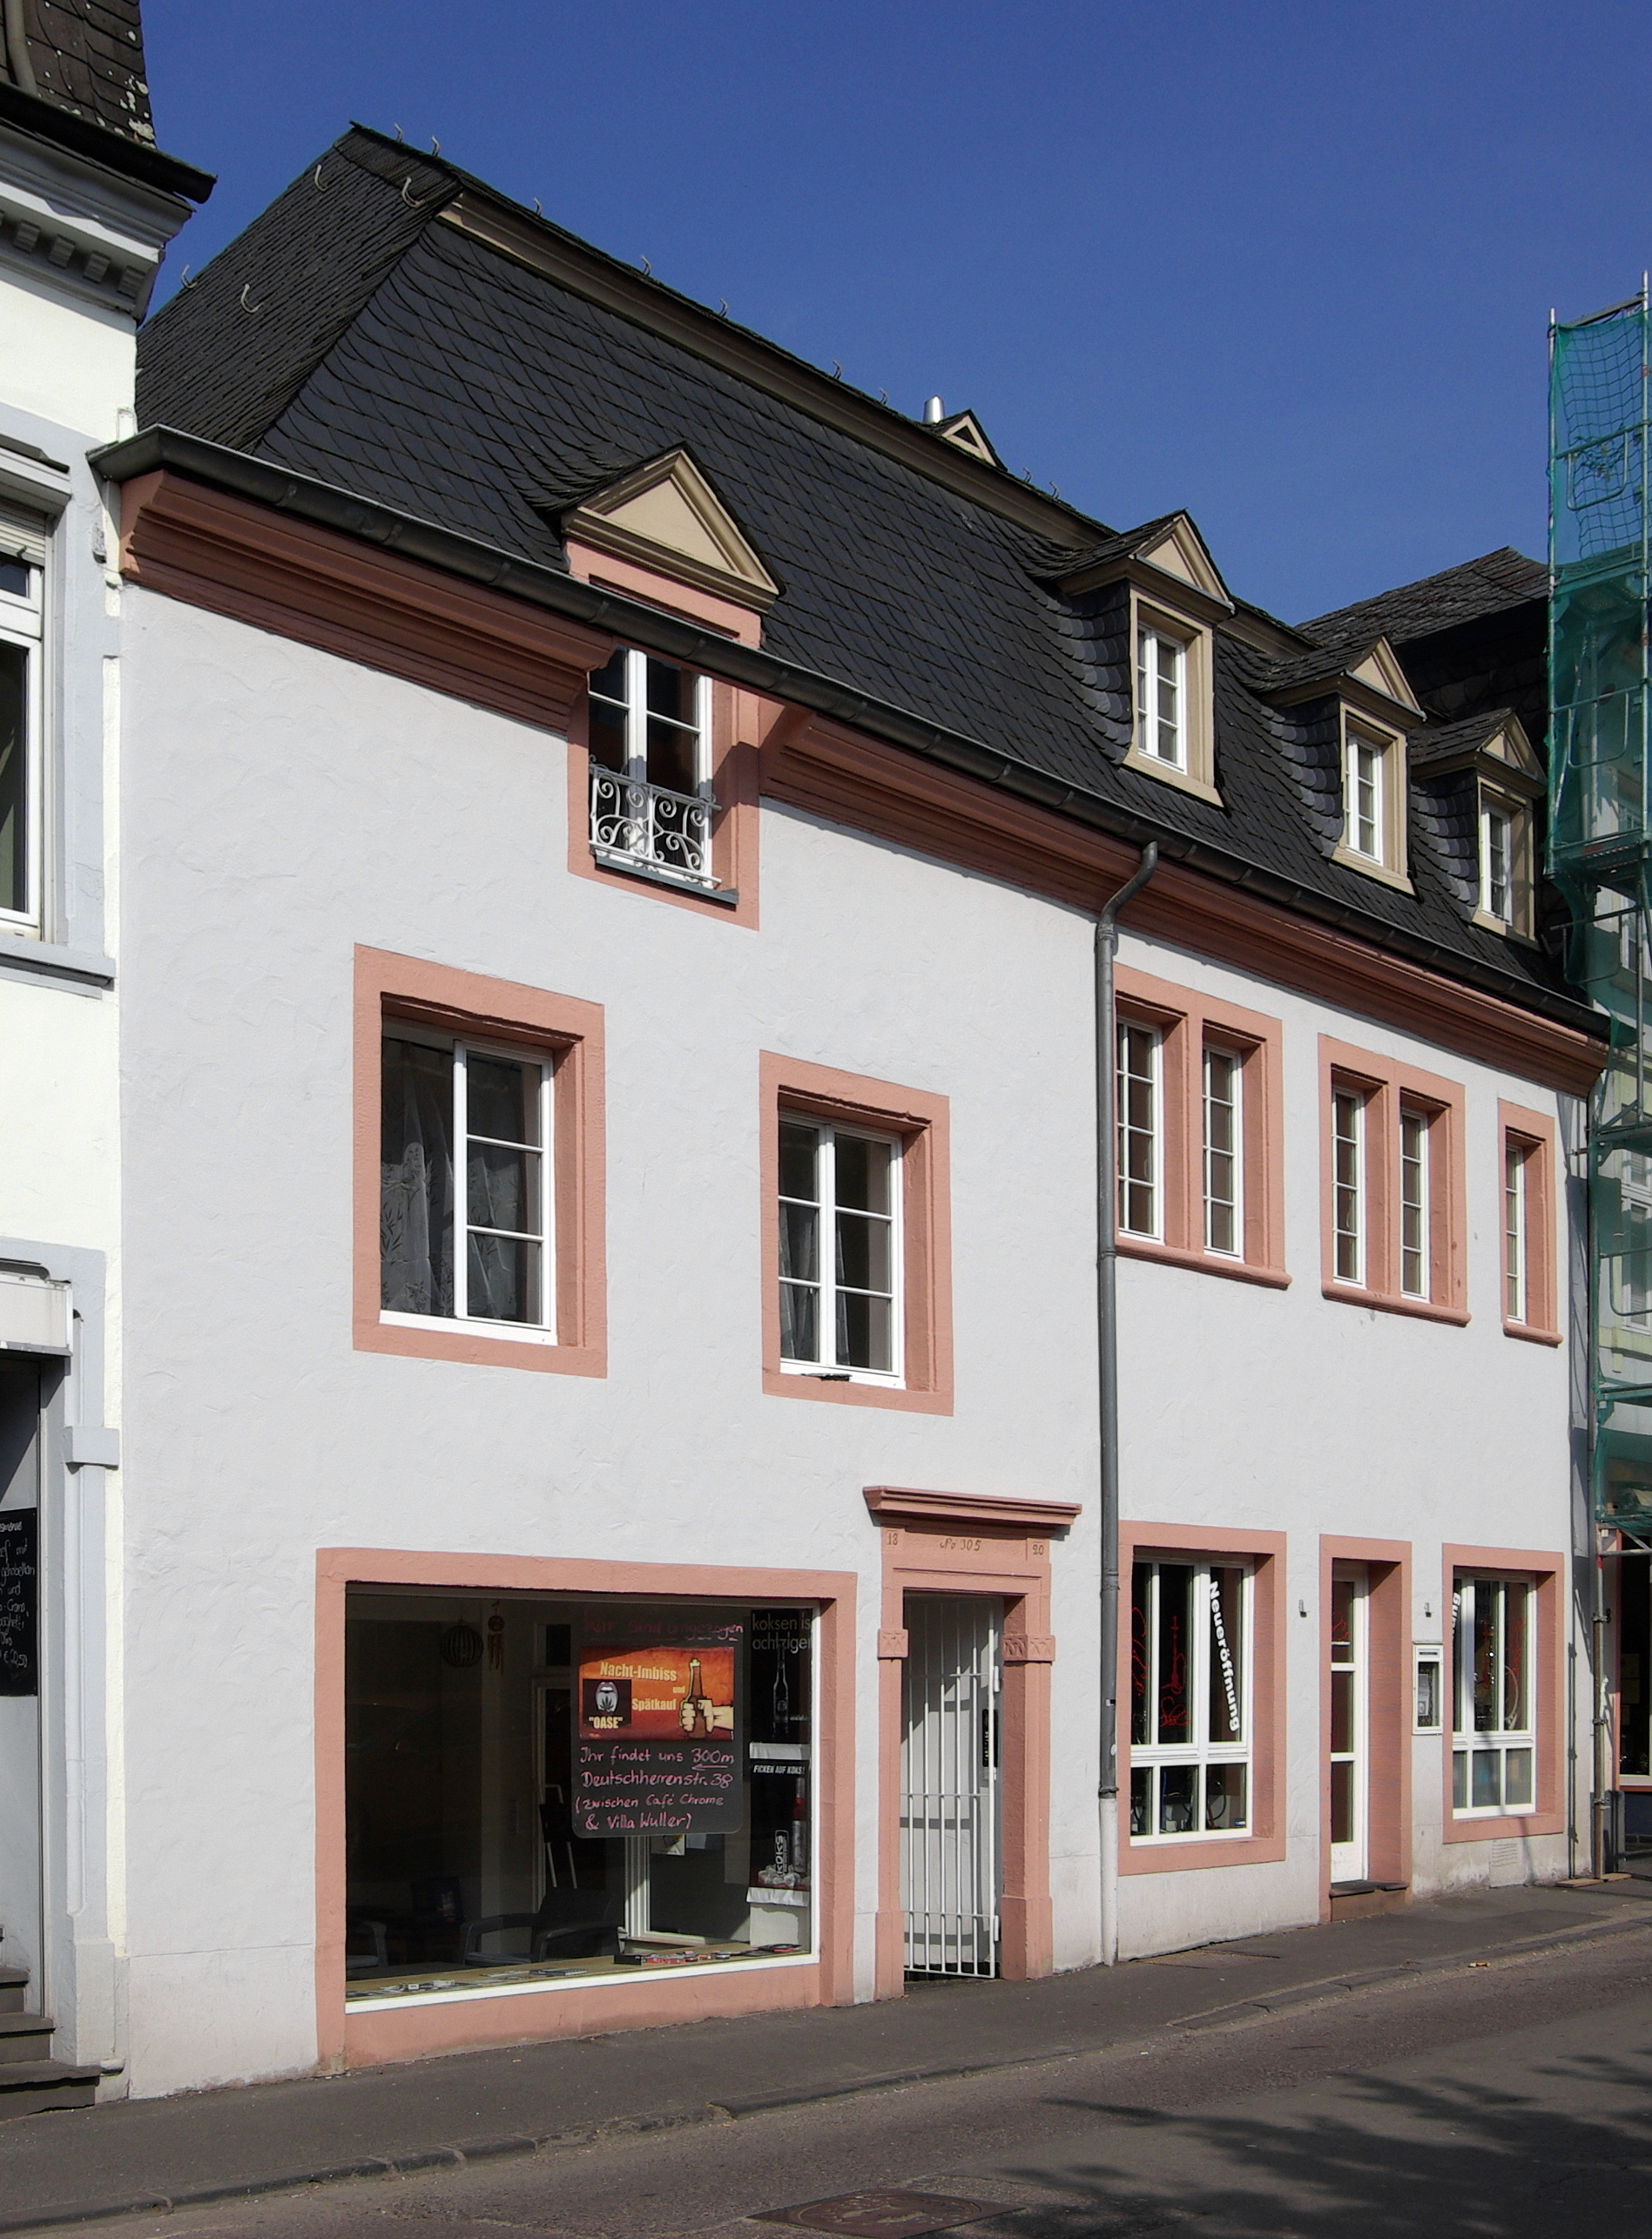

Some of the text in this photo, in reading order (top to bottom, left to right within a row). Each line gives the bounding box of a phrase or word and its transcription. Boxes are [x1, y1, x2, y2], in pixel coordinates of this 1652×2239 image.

[887, 1533, 899, 1546] 18
[960, 1539, 981, 1552] 305
[1032, 1544, 1044, 1556] 20
[752, 1613, 798, 1631] koksen
[1209, 1580, 1241, 1733] Neueröffnung
[600, 1662, 678, 1682] Nacht-Imbiss
[631, 1698, 677, 1712] Spätkauf
[610, 1745, 651, 1765] findet
[658, 1751, 684, 1763] uns
[691, 1748, 735, 1764] 300m
[645, 1793, 676, 1809] Café
[679, 1793, 725, 1806] Chrome
[585, 1813, 600, 1831] &
[607, 1814, 636, 1830] Villa
